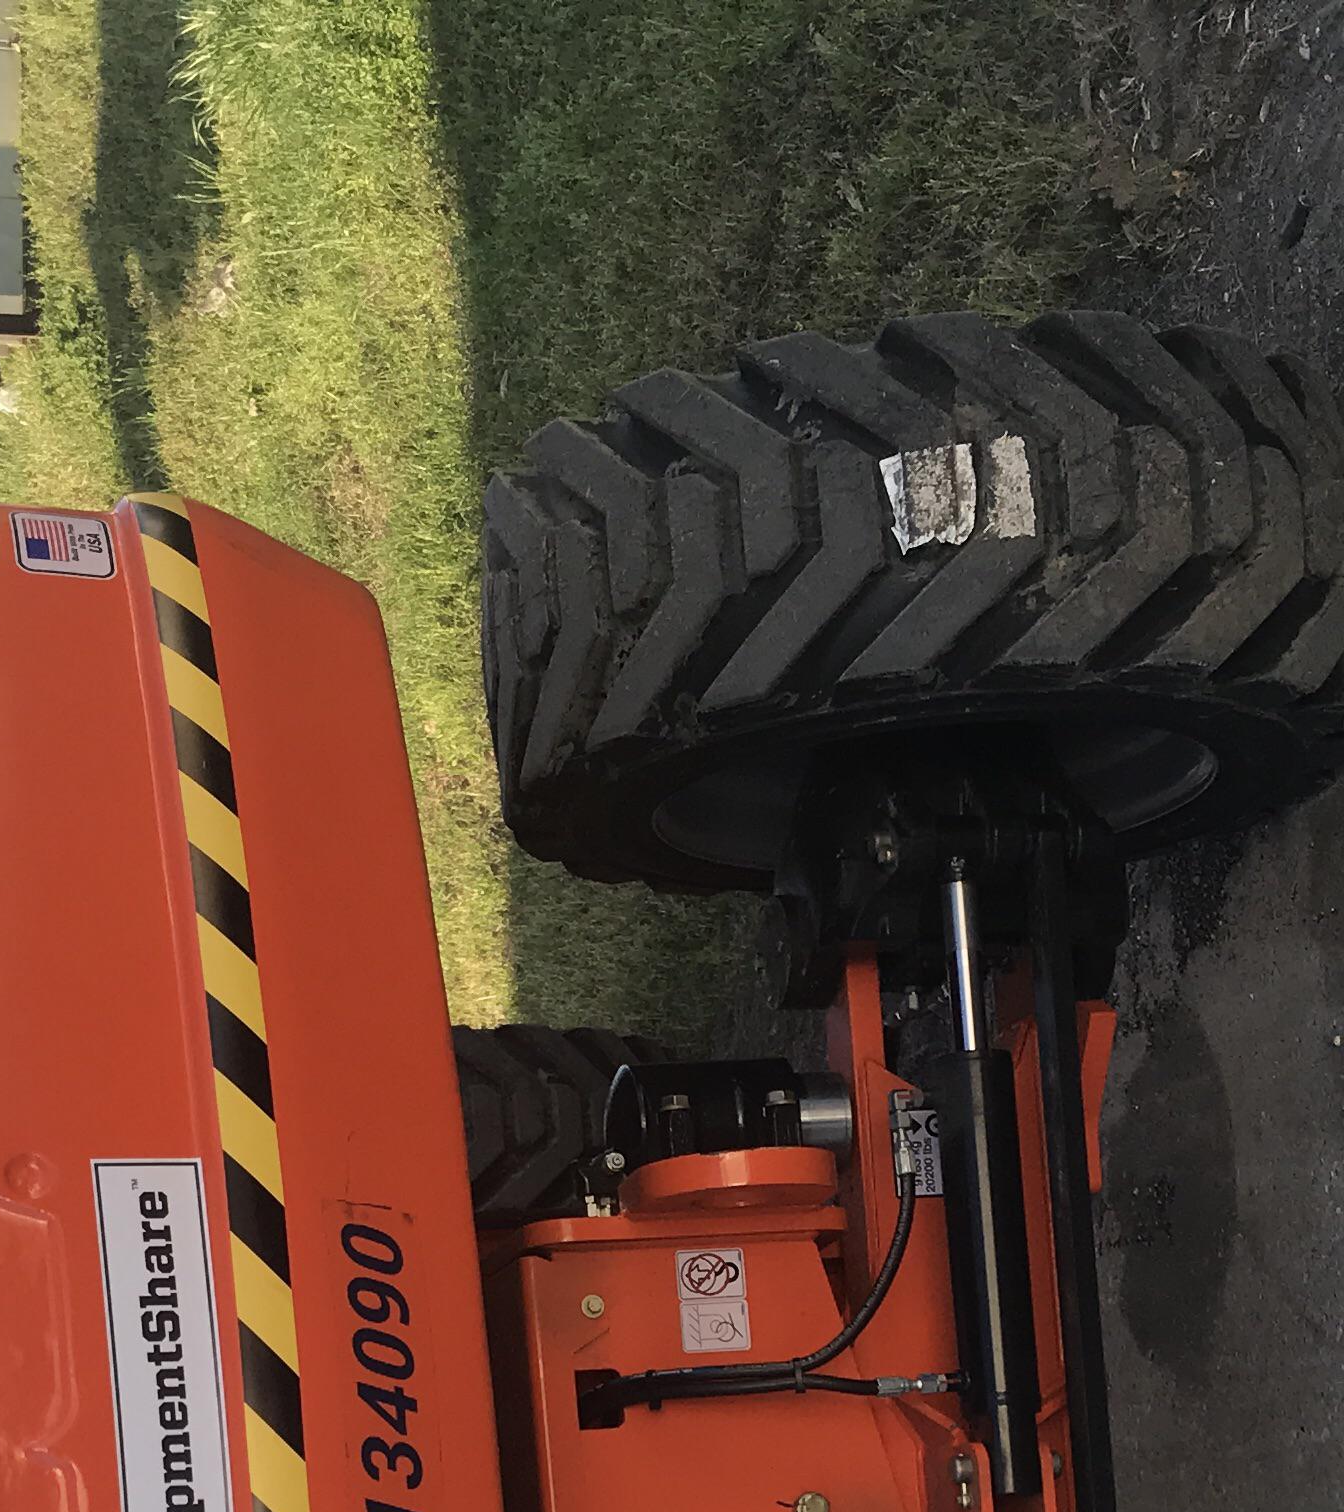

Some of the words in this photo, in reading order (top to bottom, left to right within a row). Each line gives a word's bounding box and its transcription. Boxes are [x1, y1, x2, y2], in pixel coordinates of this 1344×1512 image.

[86, 533, 103, 553] USA
[923, 1137, 932, 1155] lbs
[923, 1157, 936, 1193] 20200
